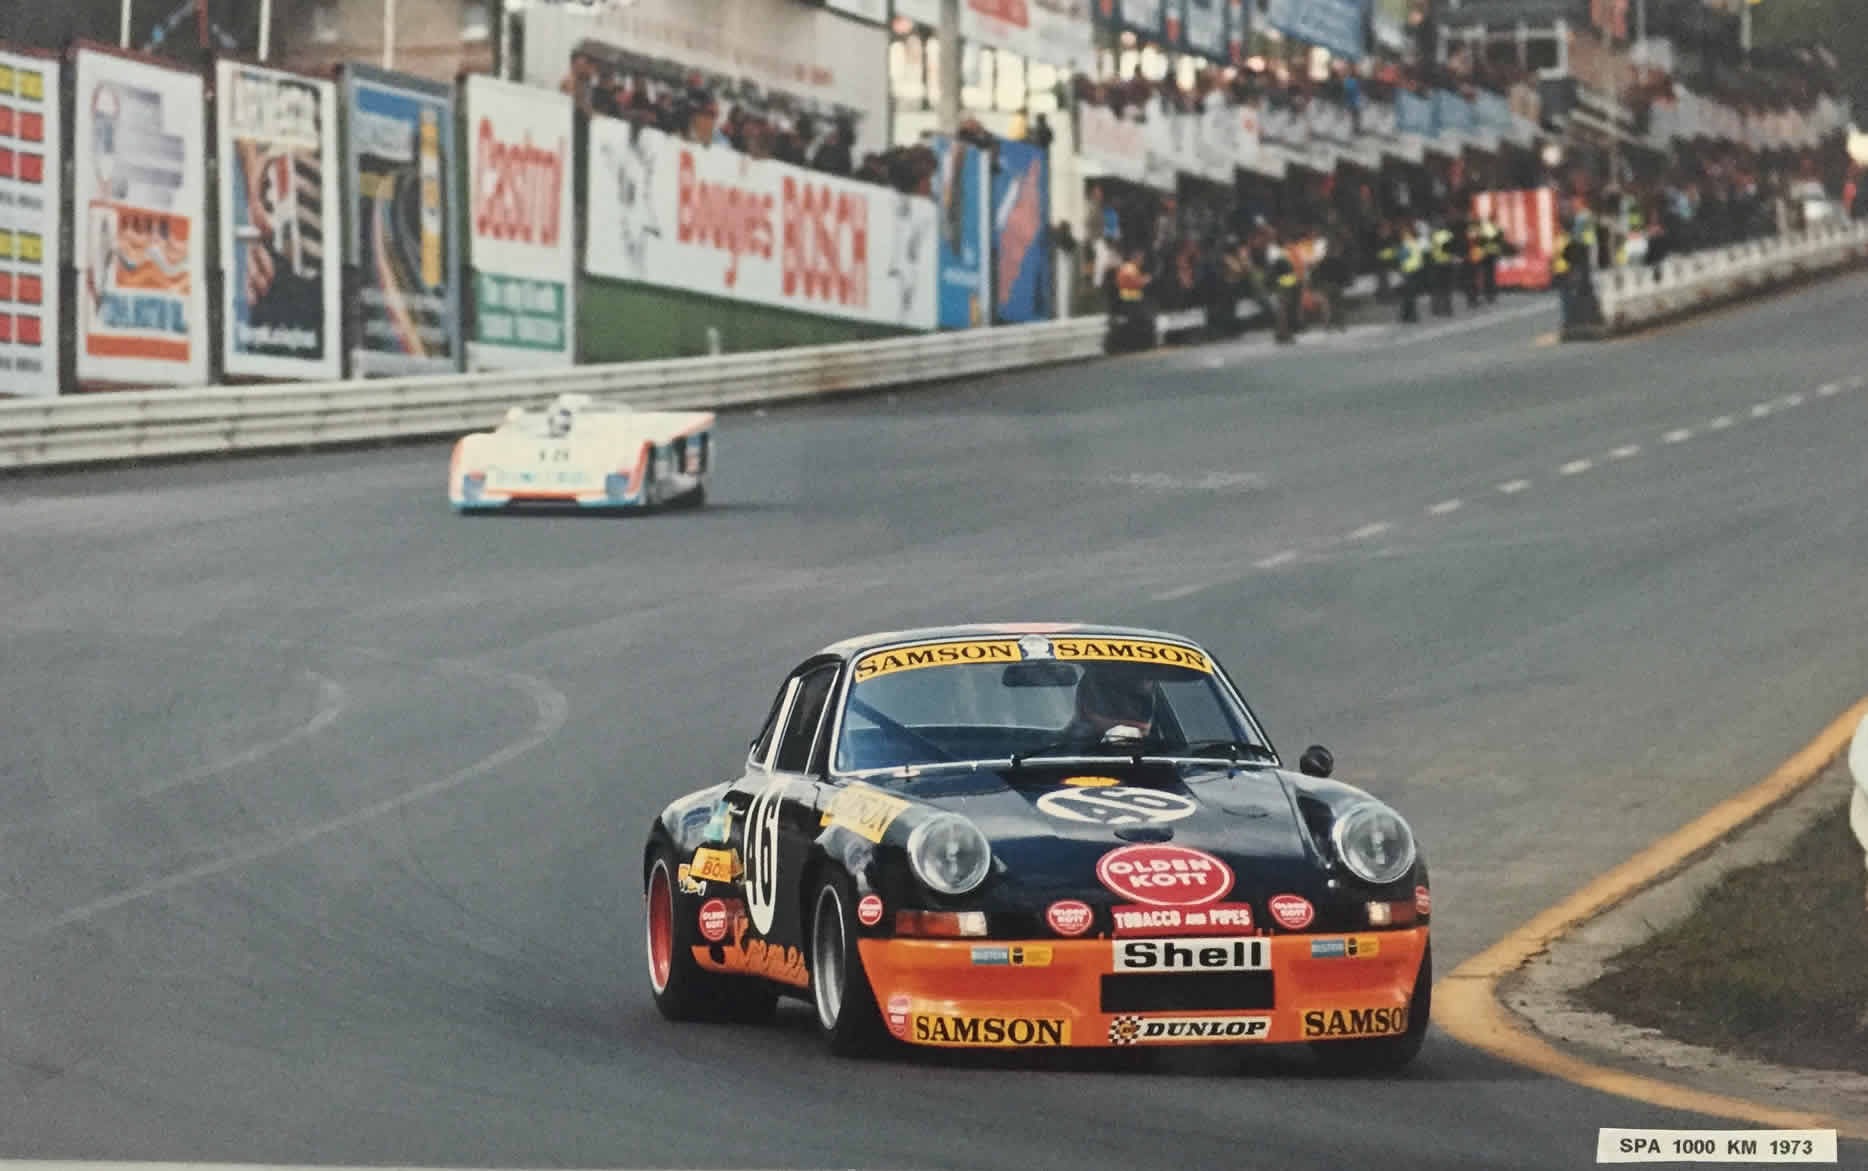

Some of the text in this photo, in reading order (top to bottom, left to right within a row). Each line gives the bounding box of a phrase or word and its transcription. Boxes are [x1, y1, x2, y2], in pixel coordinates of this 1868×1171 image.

[781, 174, 869, 310] BOSCH
[856, 643, 1013, 678] SAMSON
[1058, 642, 1207, 676] SAMSON
[1108, 859, 1212, 874] OLDEN
[1128, 872, 1209, 888] KOTT
[1114, 910, 1181, 928] TOBACCO
[1209, 909, 1250, 926] PIPES
[1124, 941, 1262, 967] Shell
[916, 1015, 1065, 1046] SAMSON
[1143, 1020, 1267, 1036] DUNLOP
[1304, 1007, 1405, 1036] SAMSO
